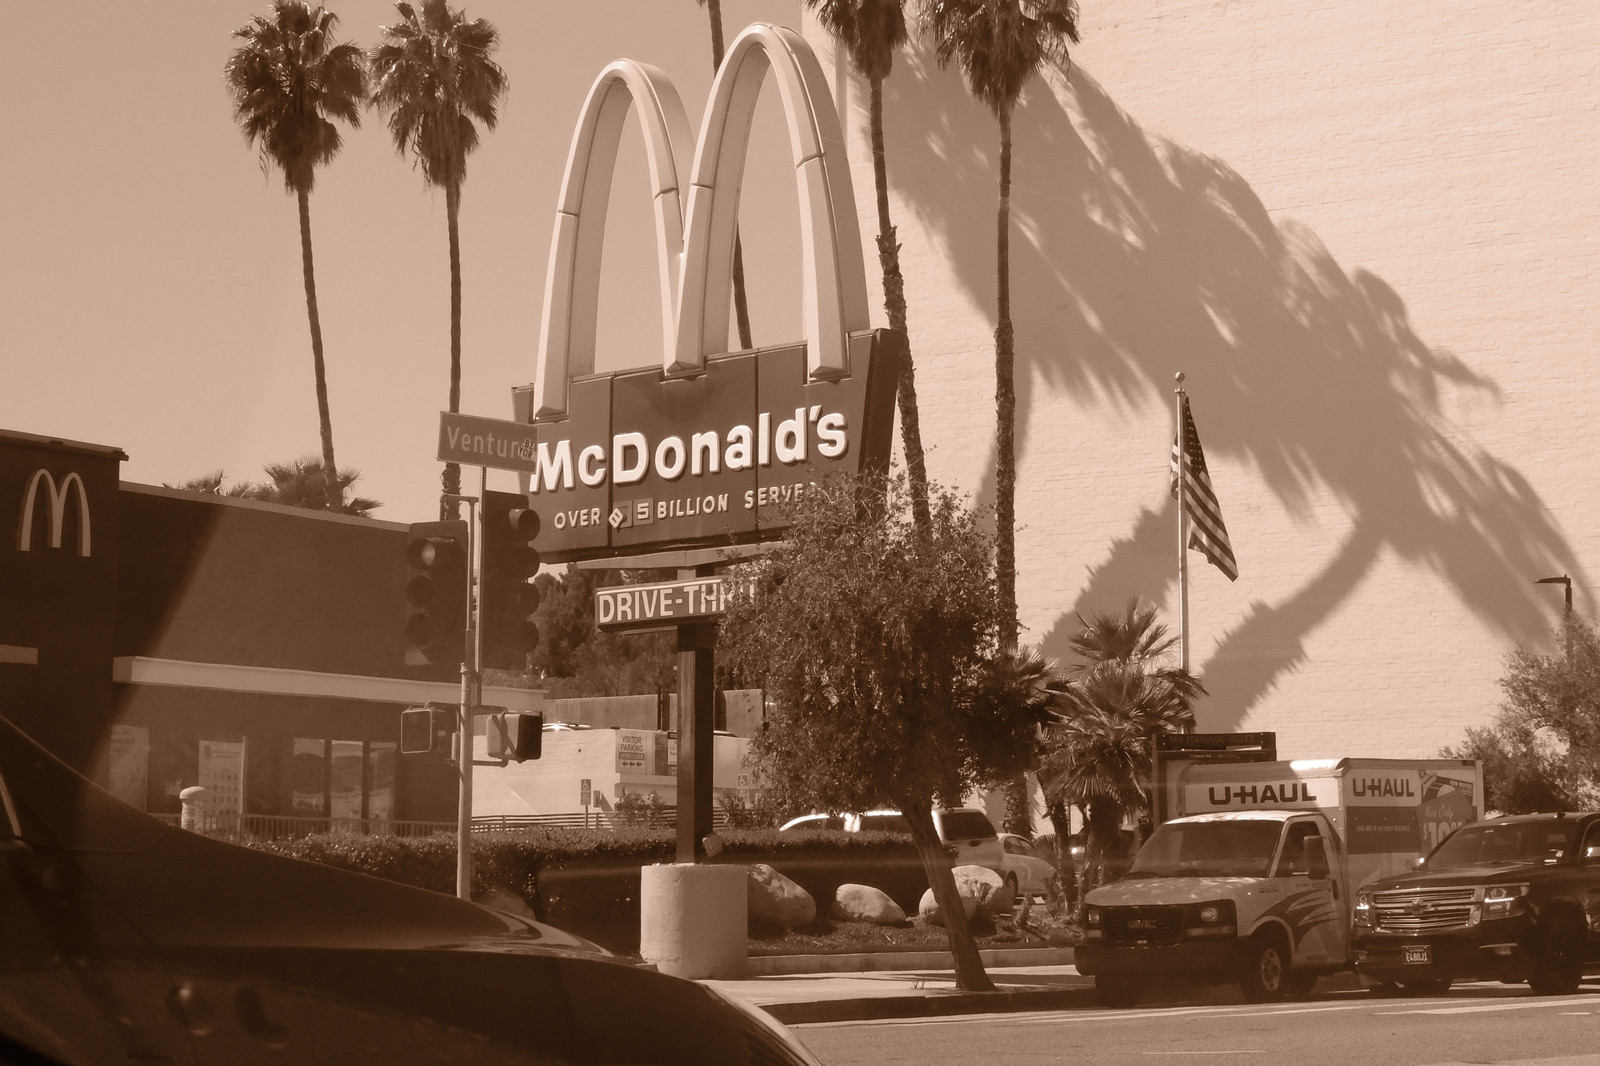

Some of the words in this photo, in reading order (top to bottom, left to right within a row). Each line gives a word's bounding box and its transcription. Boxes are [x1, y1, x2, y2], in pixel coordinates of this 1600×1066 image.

[447, 425, 530, 461] Ventur
[530, 404, 848, 493] McDonald's
[554, 507, 600, 529] OVER
[657, 493, 729, 520] BILLION
[744, 481, 816, 509] SERVE
[620, 743, 643, 752] PARKING
[621, 735, 642, 744] VISITOR
[1208, 782, 1317, 805] U-HAUL
[1352, 777, 1415, 798] U-HAUL
